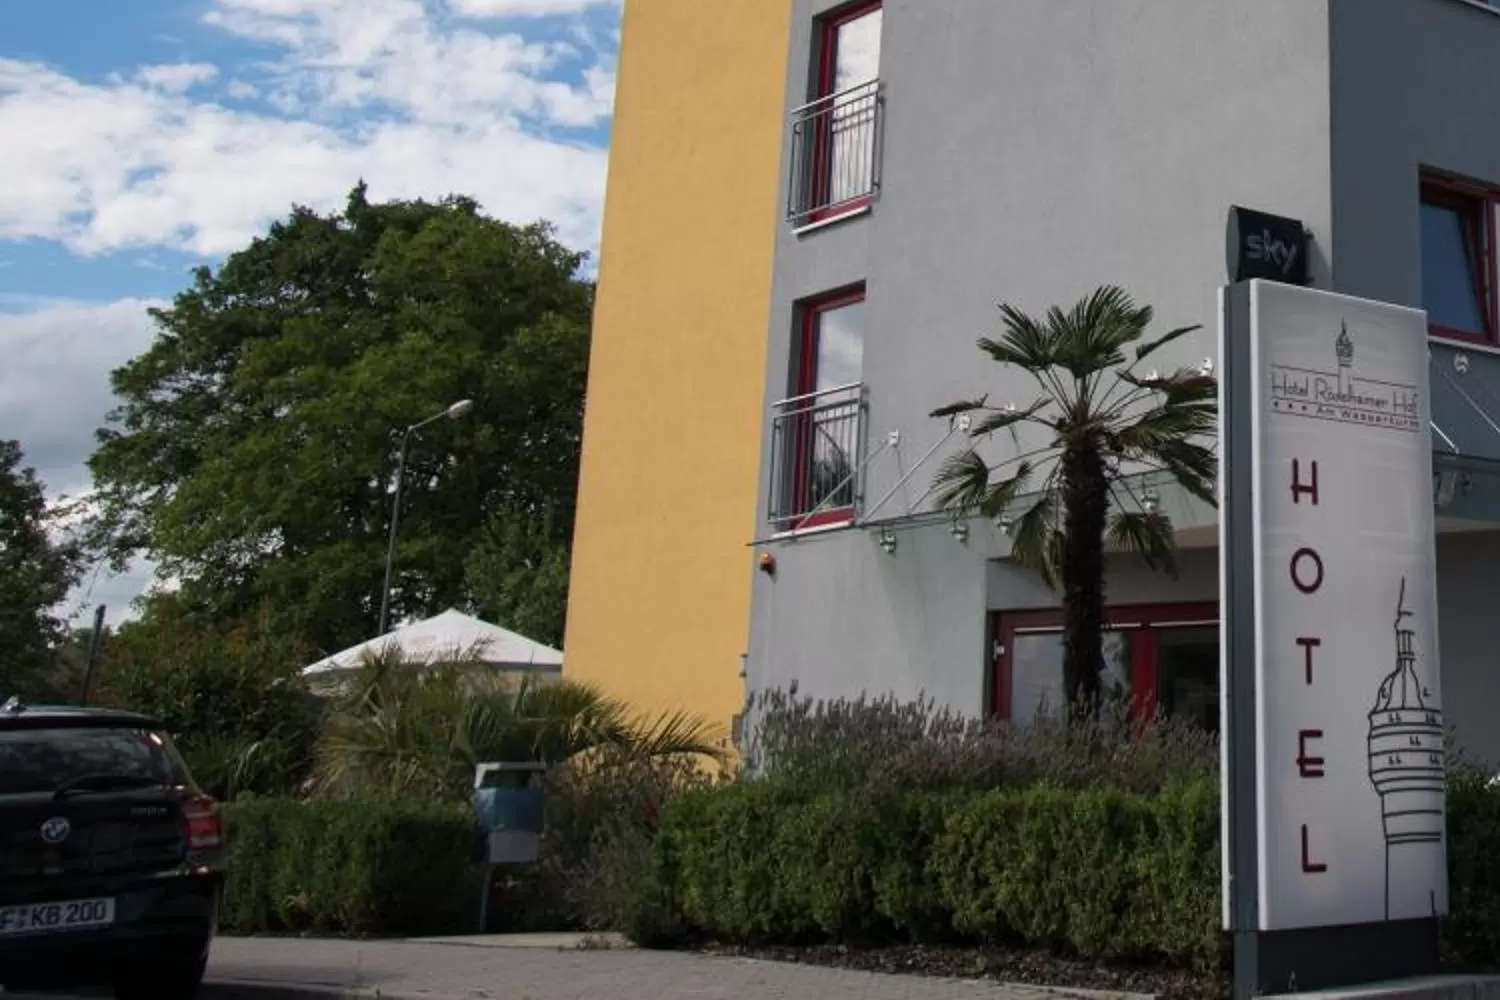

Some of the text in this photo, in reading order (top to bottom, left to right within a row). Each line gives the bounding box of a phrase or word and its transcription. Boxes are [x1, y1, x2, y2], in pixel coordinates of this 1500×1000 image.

[1247, 228, 1297, 273] sky
[1271, 371, 1309, 396] Hotel
[1289, 458, 1327, 873] HOTEL
[66, 901, 106, 922] 200
